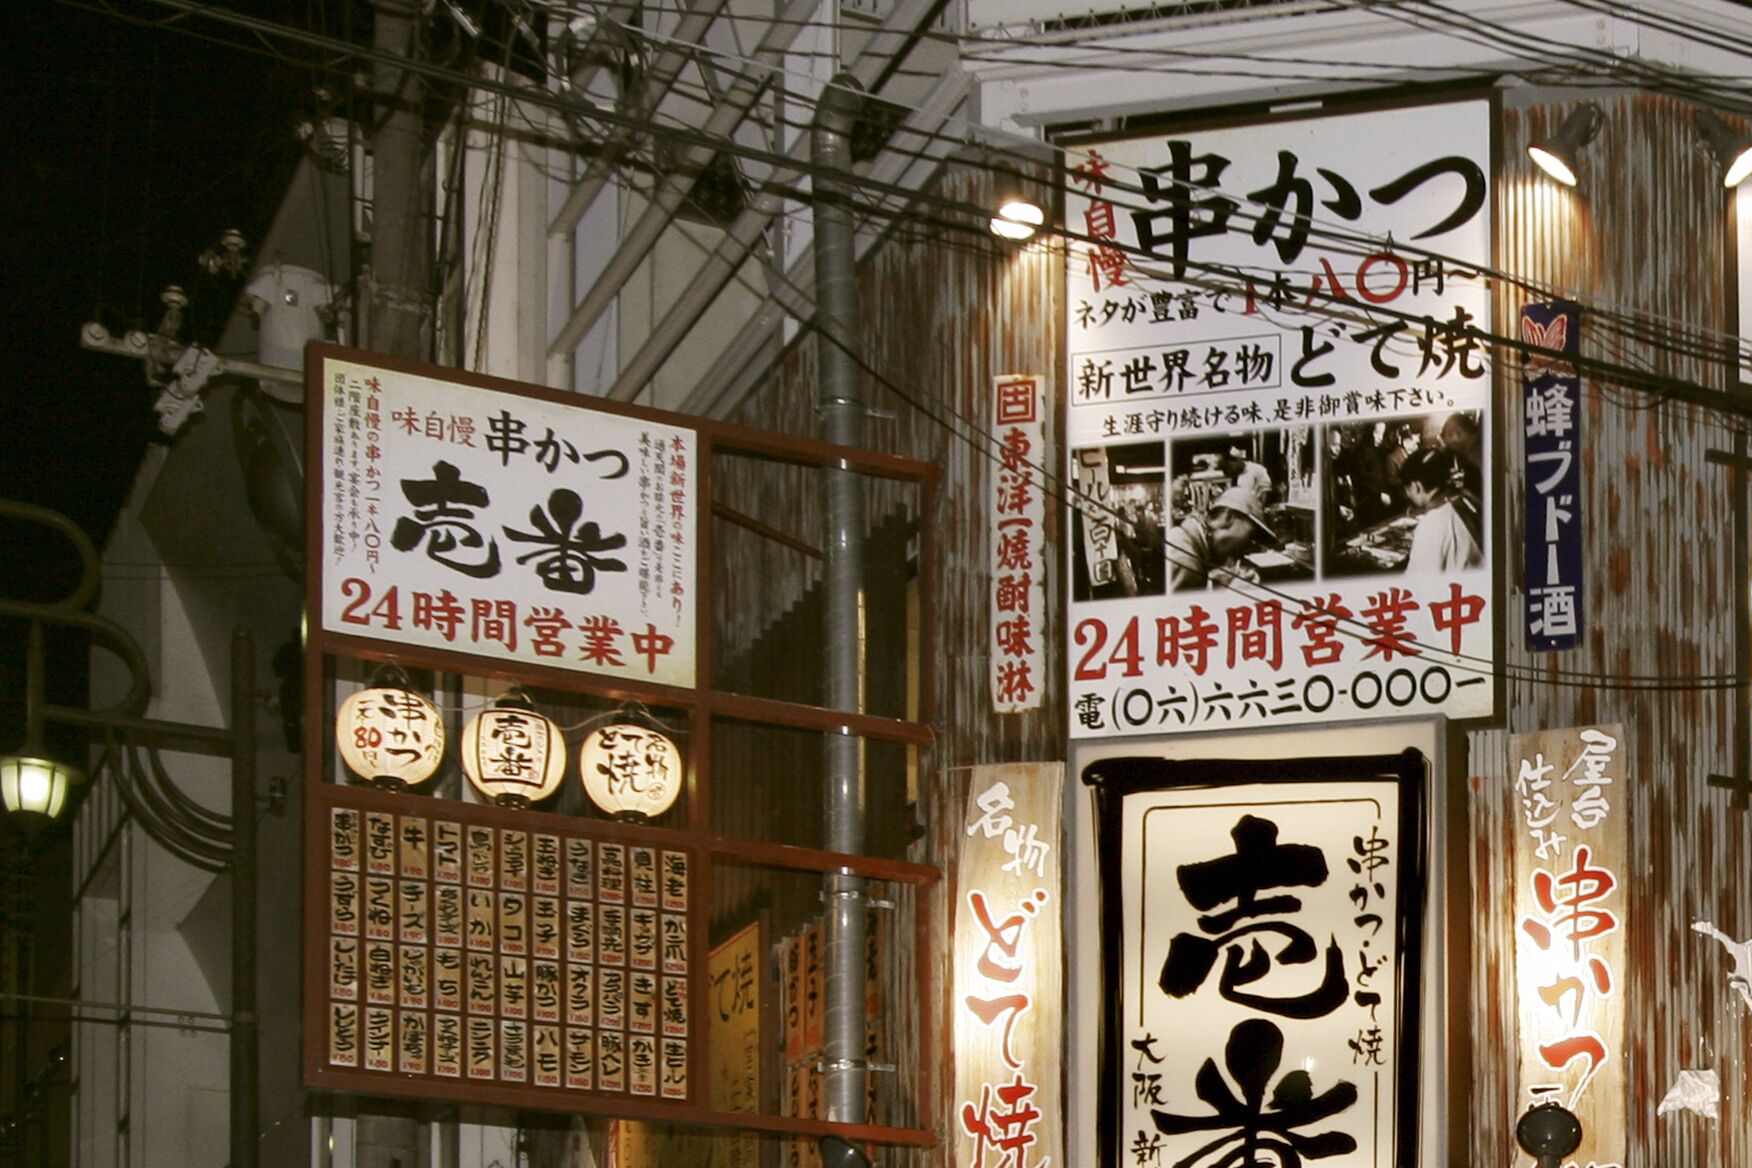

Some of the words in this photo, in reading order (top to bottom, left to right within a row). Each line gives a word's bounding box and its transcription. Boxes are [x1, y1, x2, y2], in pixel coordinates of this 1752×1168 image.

[1131, 140, 1486, 280] 串かつ
[1077, 346, 1273, 400] 新世界名物
[1290, 306, 1487, 388] どて焼
[391, 407, 477, 449] 味自慢
[486, 409, 629, 480] 串かつ
[389, 460, 629, 595] 壱番
[1524, 392, 1577, 636] 蜂ブドー酒
[340, 577, 675, 674] 24時間営業中
[1074, 582, 1486, 683] 24時間営業中
[379, 693, 428, 766] 串かつ
[489, 715, 532, 777] 壱番
[1515, 752, 1568, 860] 仕込み
[1562, 728, 1618, 830] 屋台
[368, 816, 393, 860] なすび
[404, 826, 425, 850] 牛
[966, 781, 1050, 877] 名物
[469, 894, 492, 937] いか
[1347, 826, 1389, 1067] 串かつ・どて焼
[1521, 844, 1619, 1116] 串かつ
[1130, 1033, 1167, 1107] 大阪
